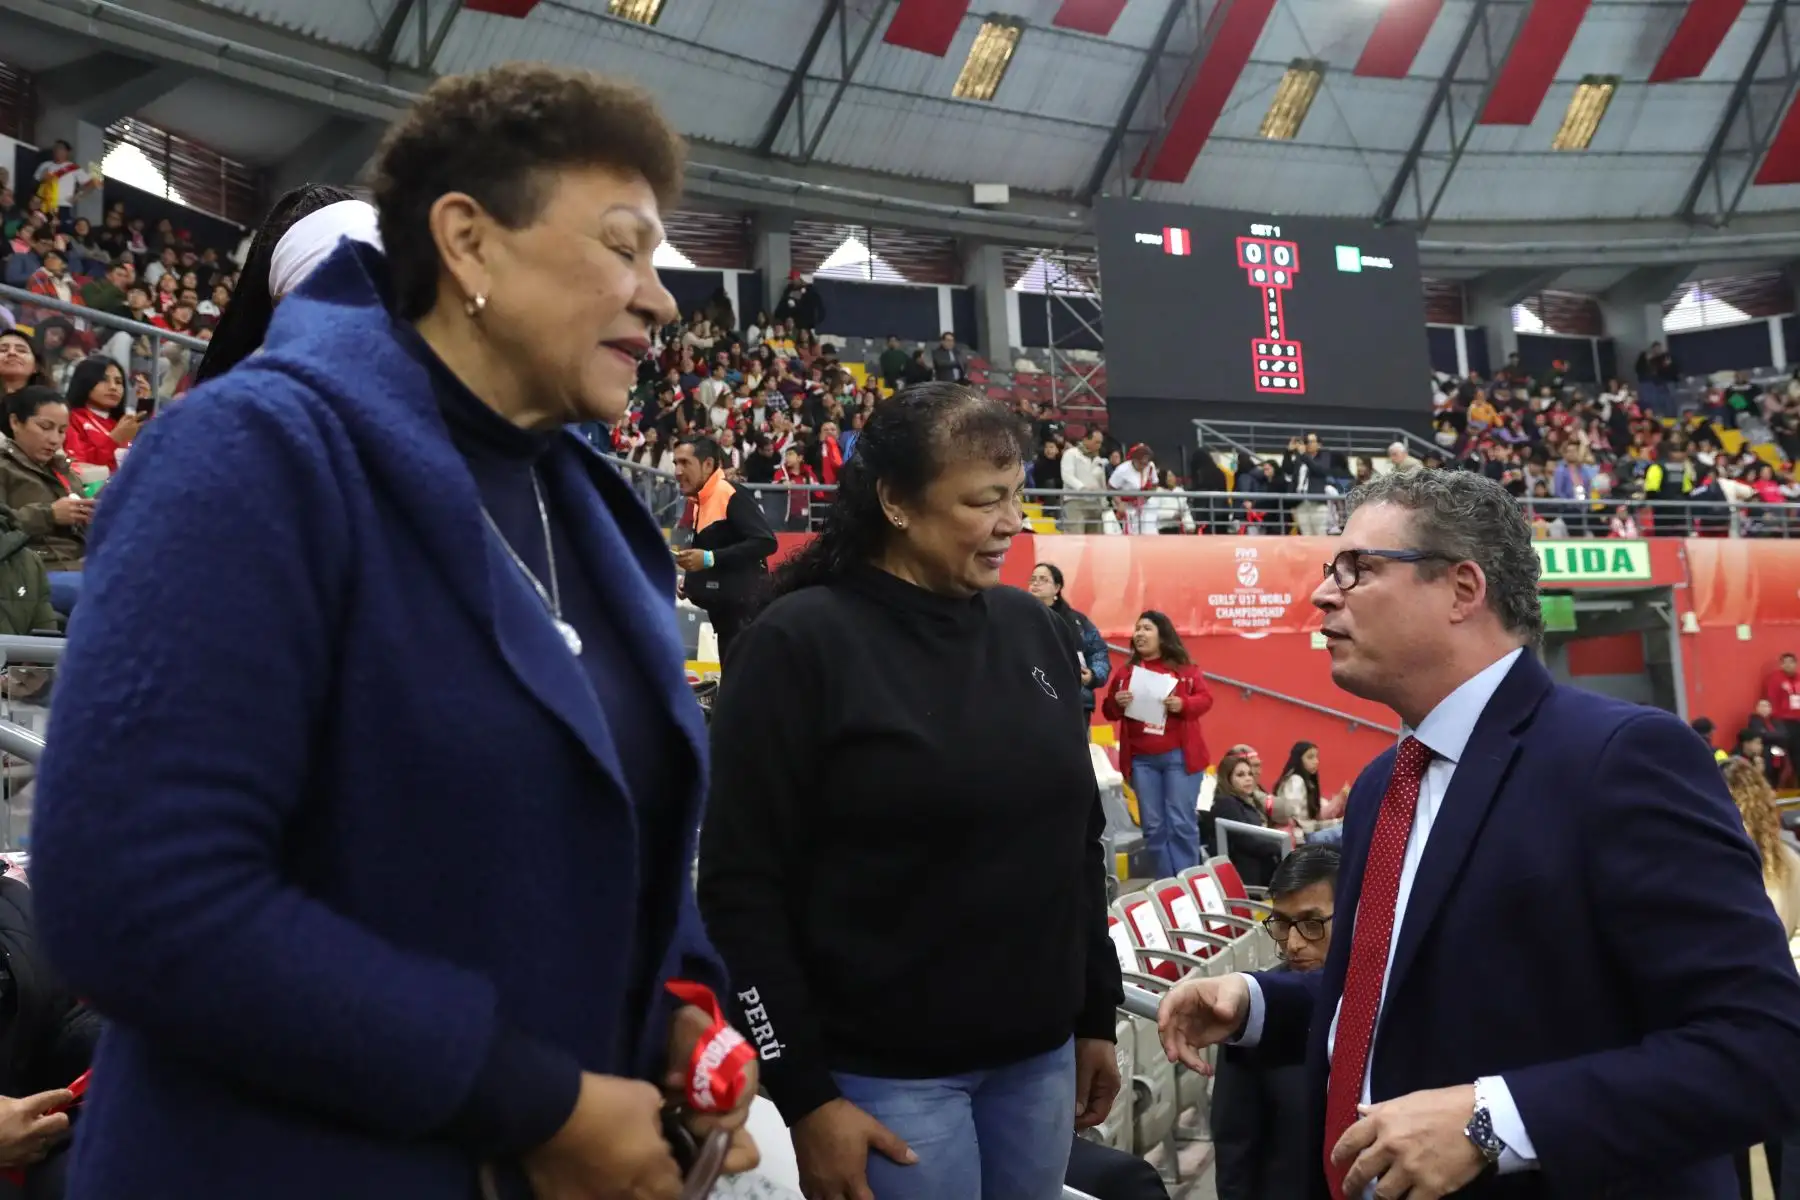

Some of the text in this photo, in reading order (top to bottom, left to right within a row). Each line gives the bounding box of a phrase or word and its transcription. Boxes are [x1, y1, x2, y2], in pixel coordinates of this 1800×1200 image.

[1250, 223, 1281, 238] SET 1
[1245, 243, 1290, 267] 0 0
[1544, 547, 1636, 573] LIDA
[1260, 594, 1292, 605] WORLD
[1216, 607, 1285, 619] CHAMPIONSHIP
[737, 986, 786, 1061] PERÚ
